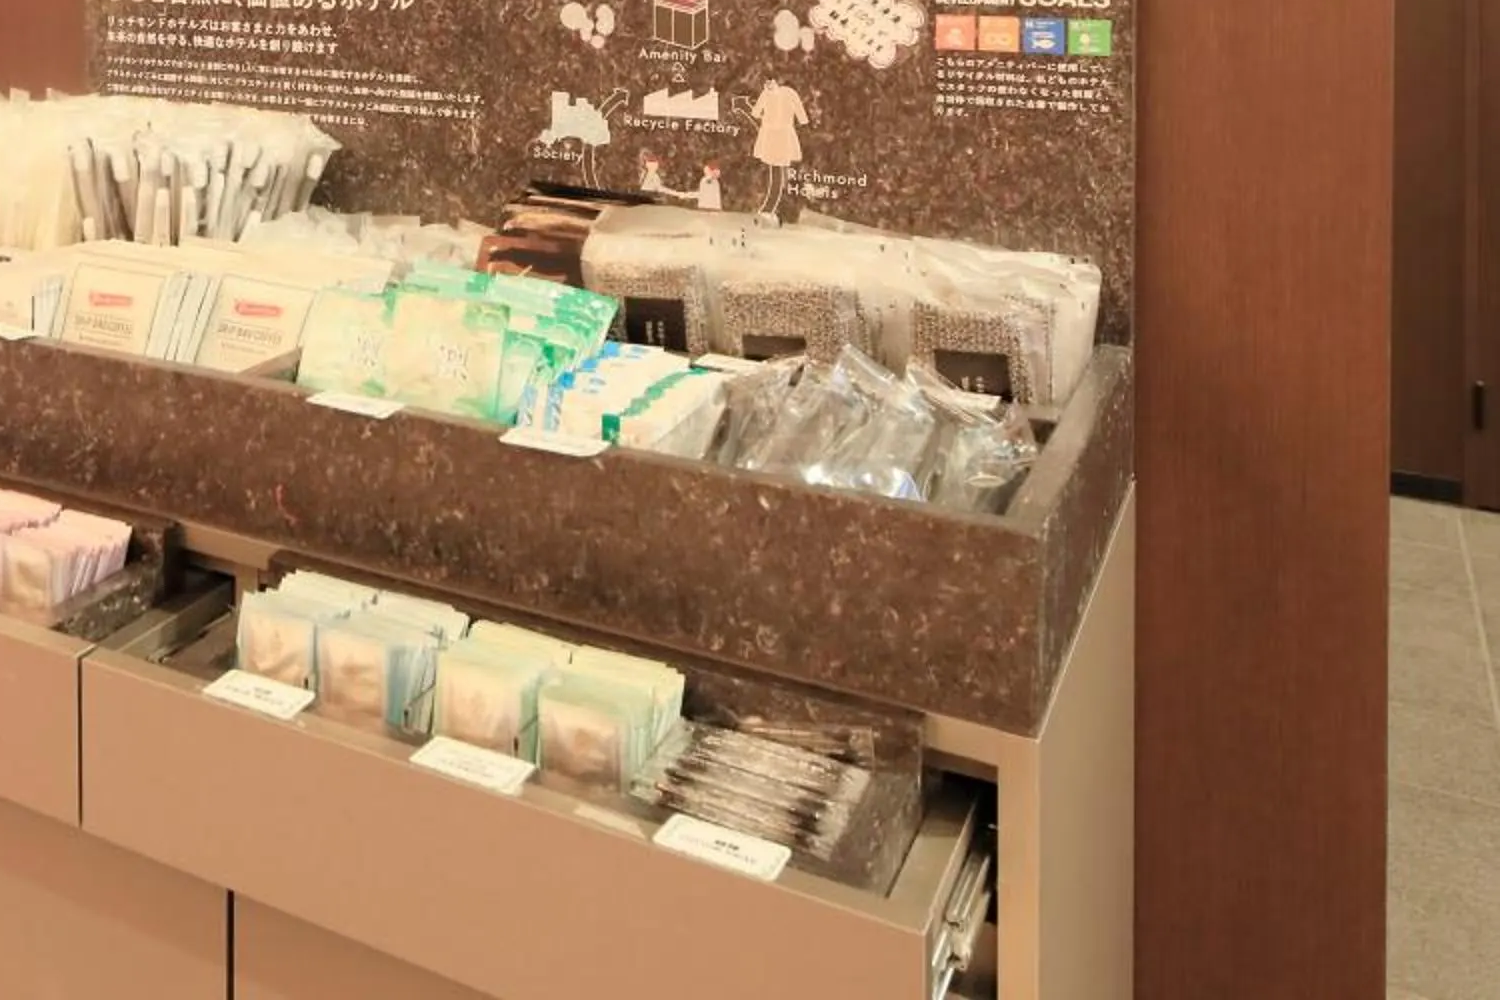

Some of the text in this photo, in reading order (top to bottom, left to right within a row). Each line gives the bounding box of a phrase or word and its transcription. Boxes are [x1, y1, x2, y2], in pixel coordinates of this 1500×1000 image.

[638, 47, 728, 64] Amenity Bar
[623, 115, 741, 137] Recycle Factory
[533, 145, 584, 164] Society
[787, 168, 868, 187] Richmond
[787, 182, 839, 200] Hotels
